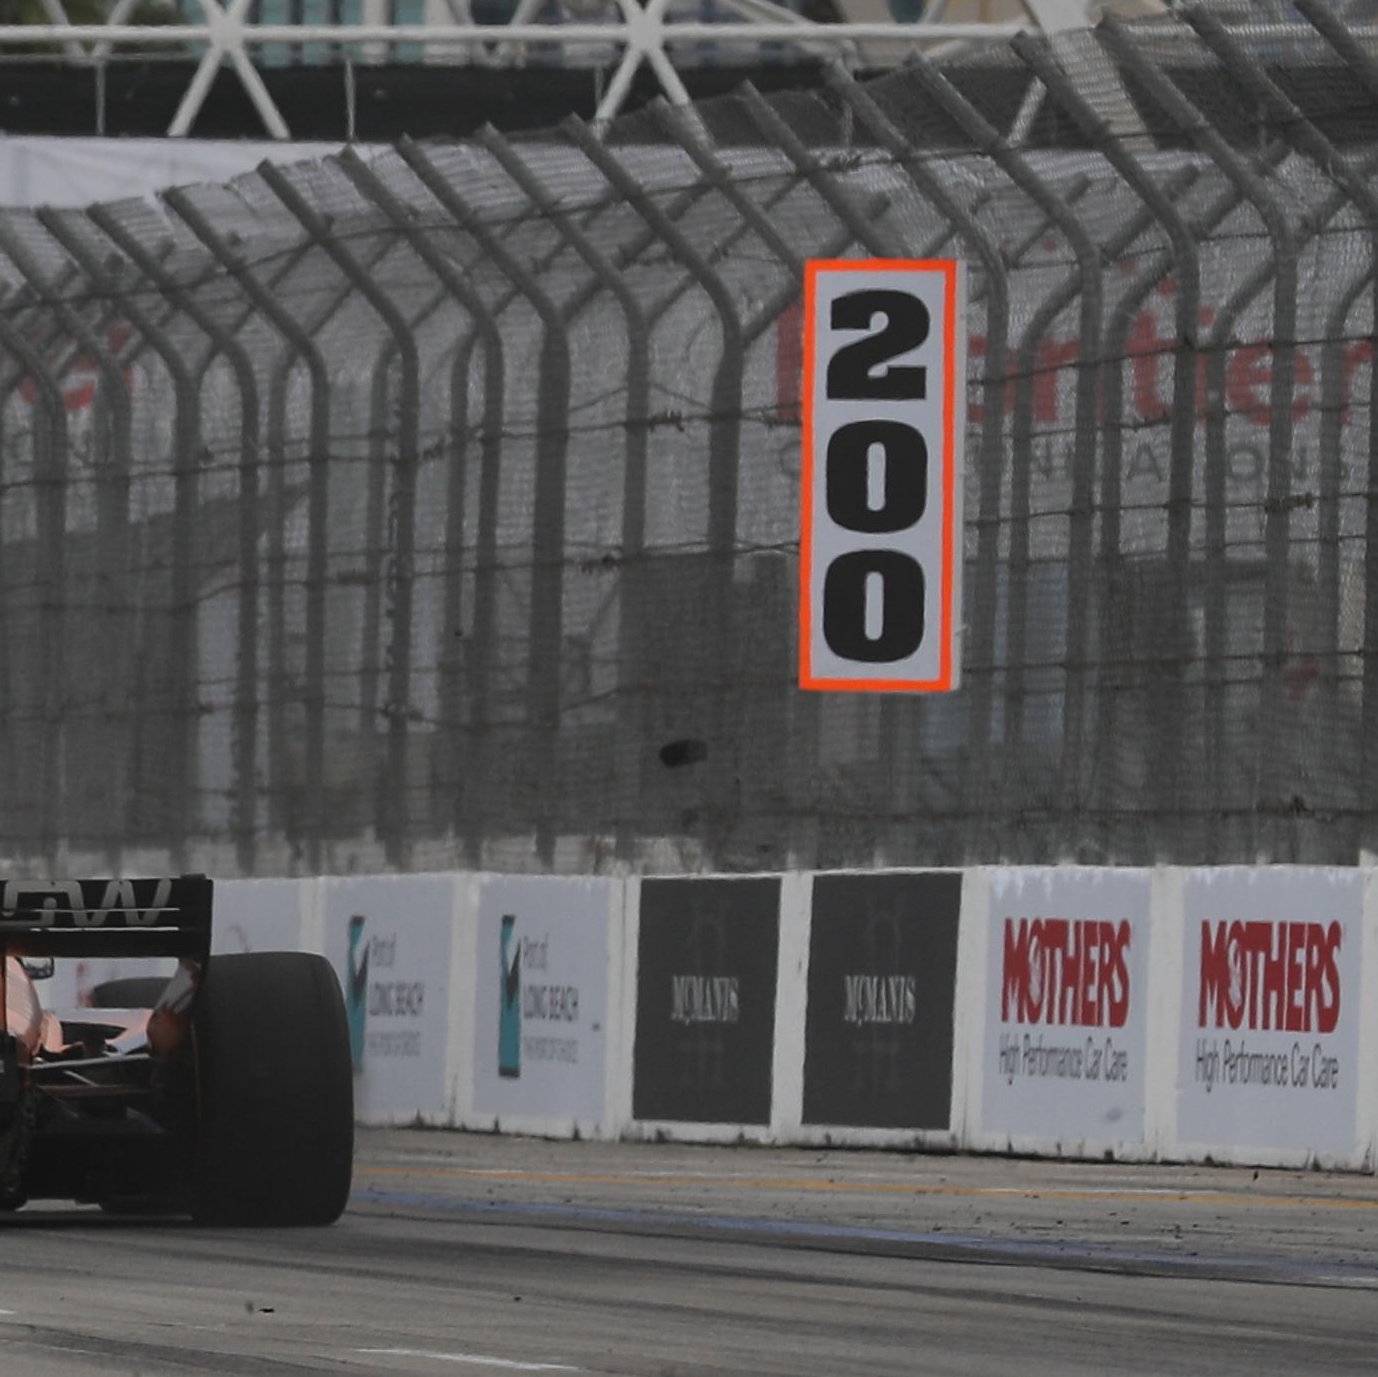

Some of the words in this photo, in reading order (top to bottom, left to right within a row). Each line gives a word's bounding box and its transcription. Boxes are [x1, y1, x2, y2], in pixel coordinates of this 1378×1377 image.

[823, 289, 931, 664] 200
[369, 981, 393, 1017] LONG
[395, 981, 425, 1017] BEACH
[1001, 917, 1132, 1028] MOTHERS
[1198, 919, 1342, 1034] MOTHERS
[523, 984, 548, 1021] LONG
[549, 984, 580, 1022] BEACH
[1000, 1033, 1020, 1085] High
[1023, 1033, 1083, 1080] Performance
[1085, 1035, 1102, 1081] Car
[1104, 1036, 1128, 1082] Care
[1196, 1037, 1220, 1092] High
[1224, 1039, 1289, 1086] Performance
[1291, 1041, 1310, 1088] Car
[1312, 1042, 1340, 1090] Care
